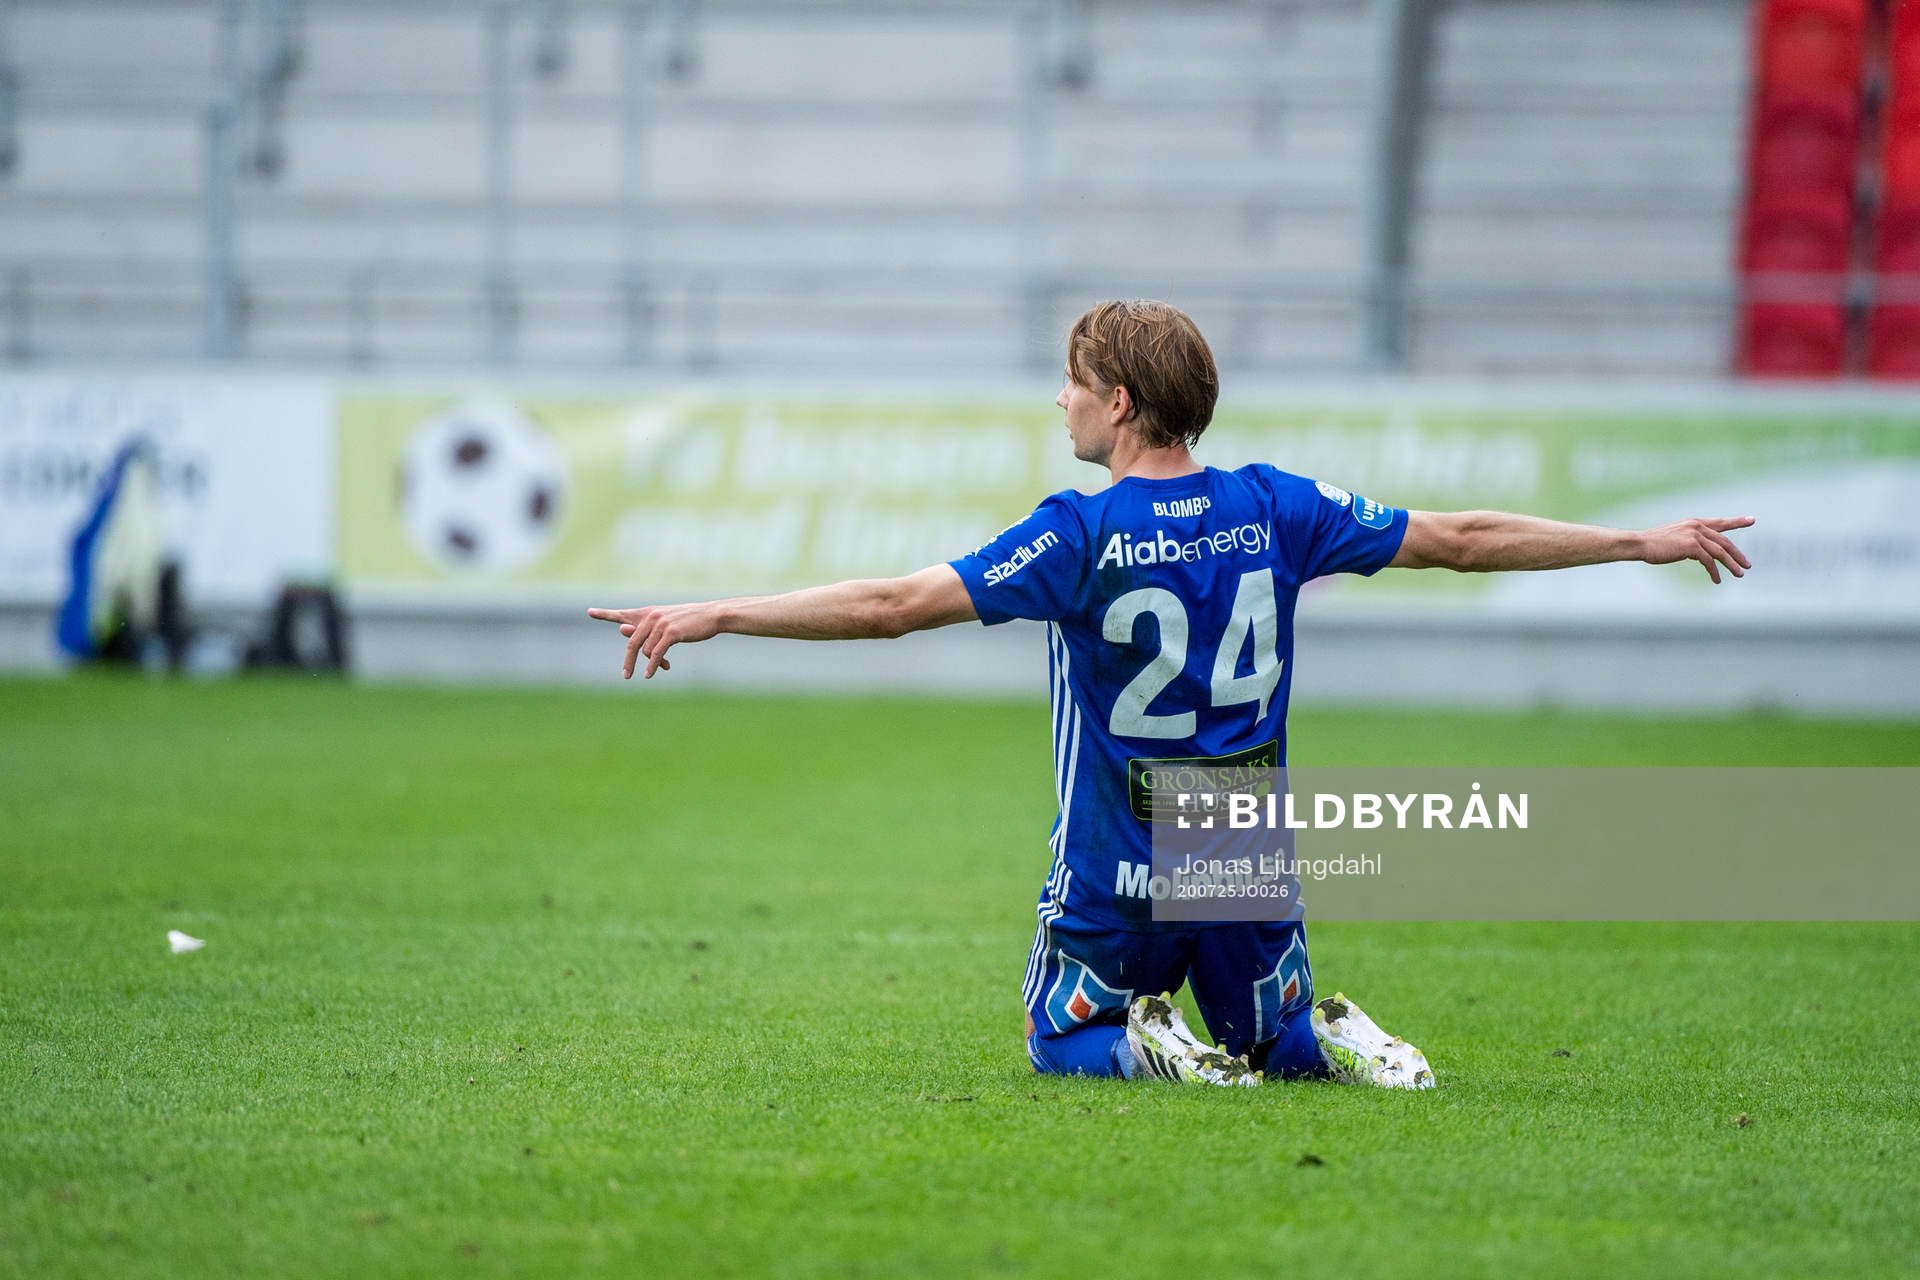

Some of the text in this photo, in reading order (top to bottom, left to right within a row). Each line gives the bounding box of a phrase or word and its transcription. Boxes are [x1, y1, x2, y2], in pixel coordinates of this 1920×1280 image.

[983, 530, 1059, 587] stadium
[1097, 520, 1271, 569] Aiabenergy
[1102, 567, 1285, 740] 24
[1140, 754, 1270, 792] GRÖNSAKS
